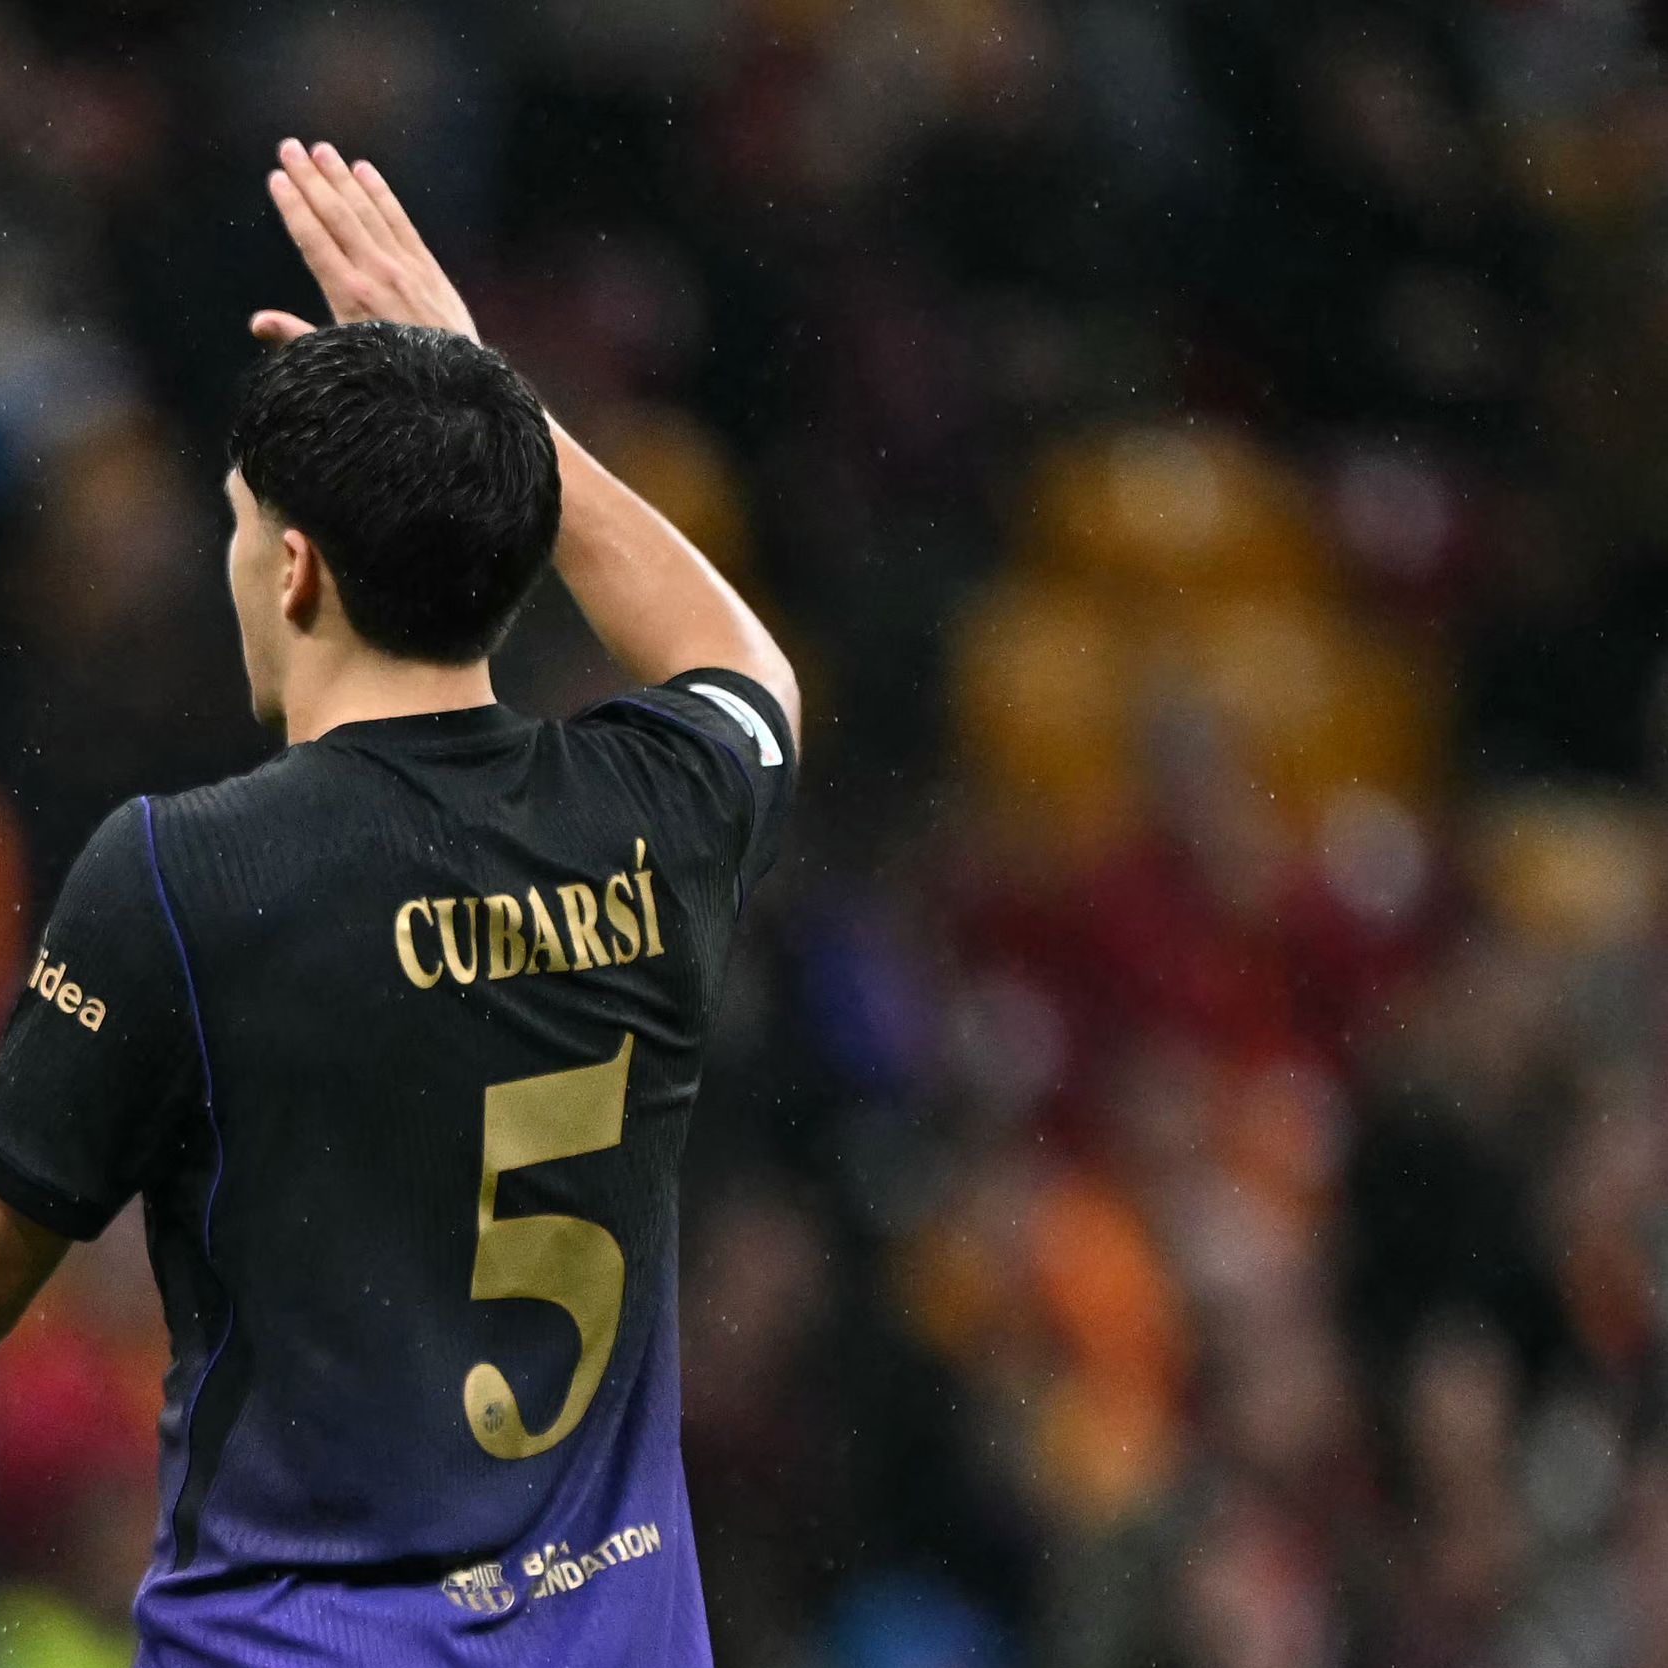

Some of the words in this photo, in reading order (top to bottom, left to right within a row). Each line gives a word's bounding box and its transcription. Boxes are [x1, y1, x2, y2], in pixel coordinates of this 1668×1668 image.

[27, 950, 107, 1032] idea
[393, 837, 666, 991] CUBARSÍ
[464, 1032, 635, 1461] 5
